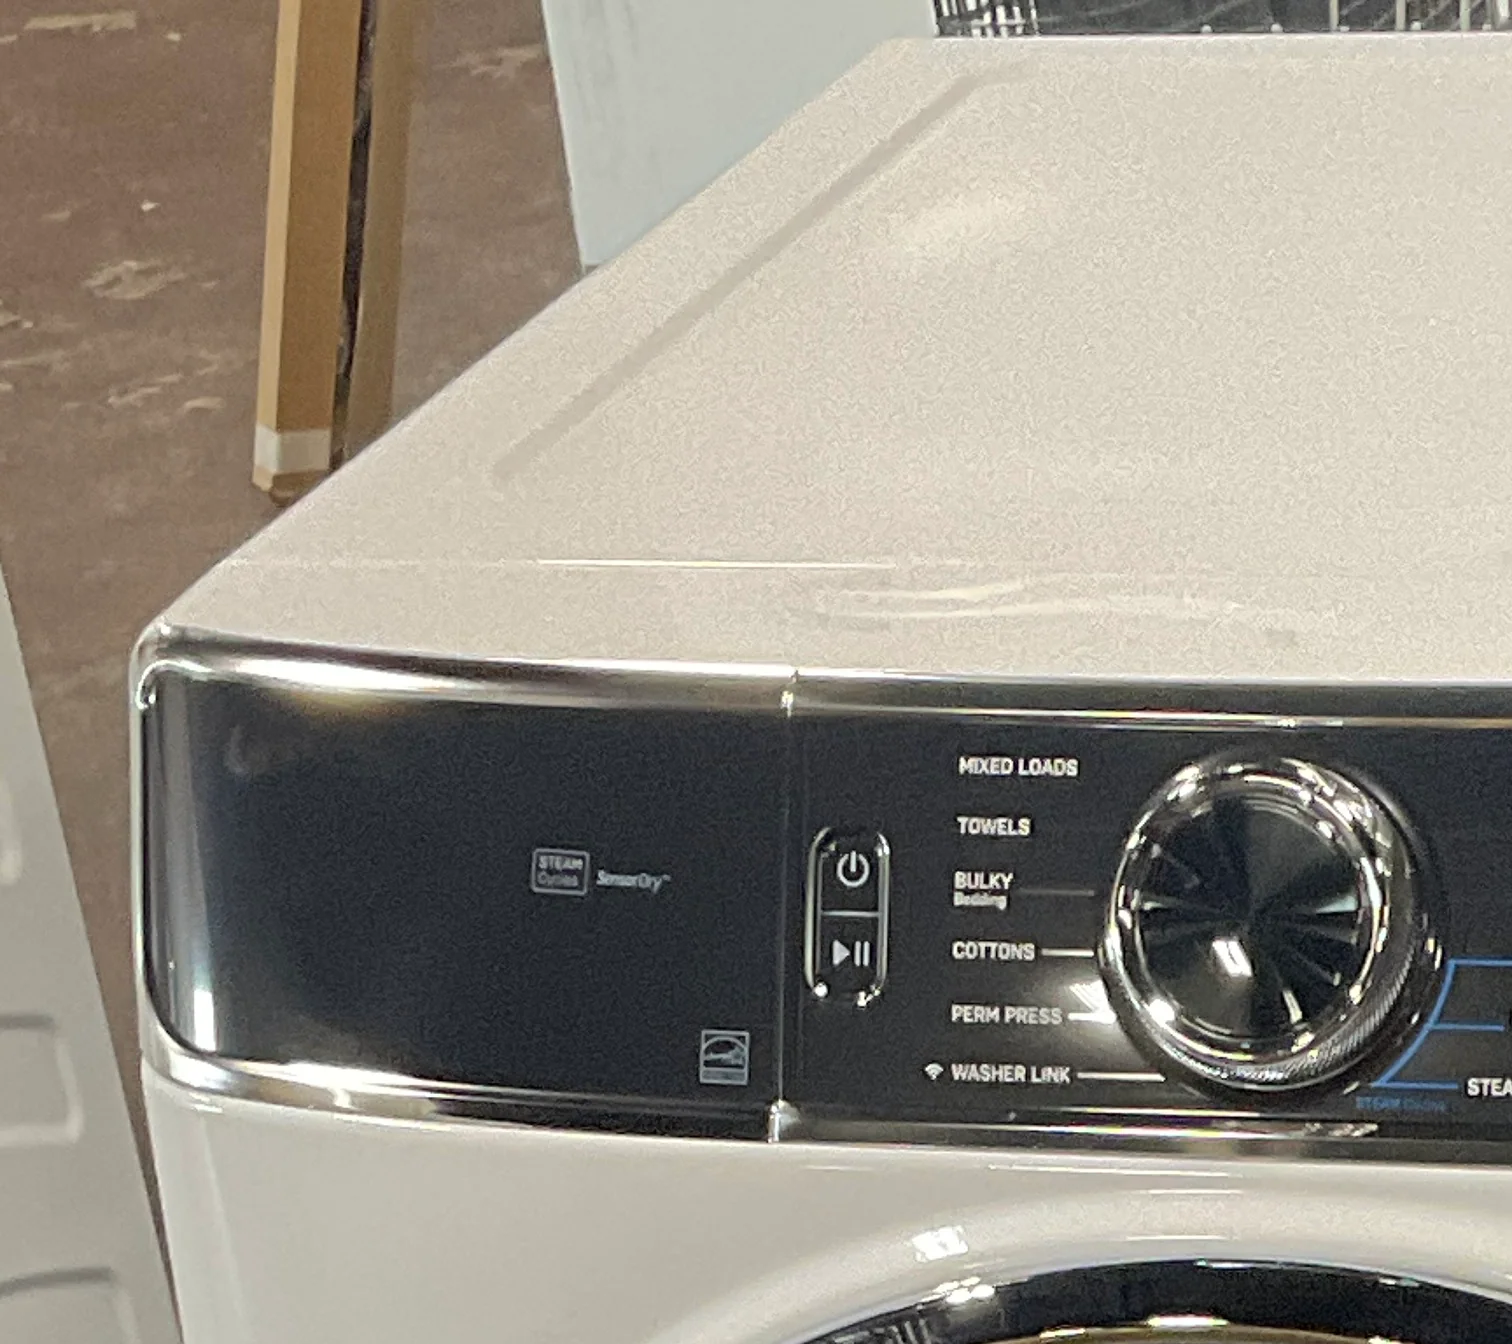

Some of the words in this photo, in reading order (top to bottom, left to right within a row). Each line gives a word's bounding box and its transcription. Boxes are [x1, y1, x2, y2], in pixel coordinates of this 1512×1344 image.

[959, 757, 1013, 775] MIXED
[1018, 758, 1078, 776] LOADS
[957, 817, 1030, 835] TOWELS
[955, 871, 1013, 889] BULKY
[954, 892, 1006, 910] Bedding
[952, 941, 1034, 960] COTTONS
[952, 1005, 999, 1022] PERM
[1005, 1006, 1063, 1025] PRESS
[952, 1064, 1026, 1082] WASHER
[1031, 1067, 1070, 1083] LINK
